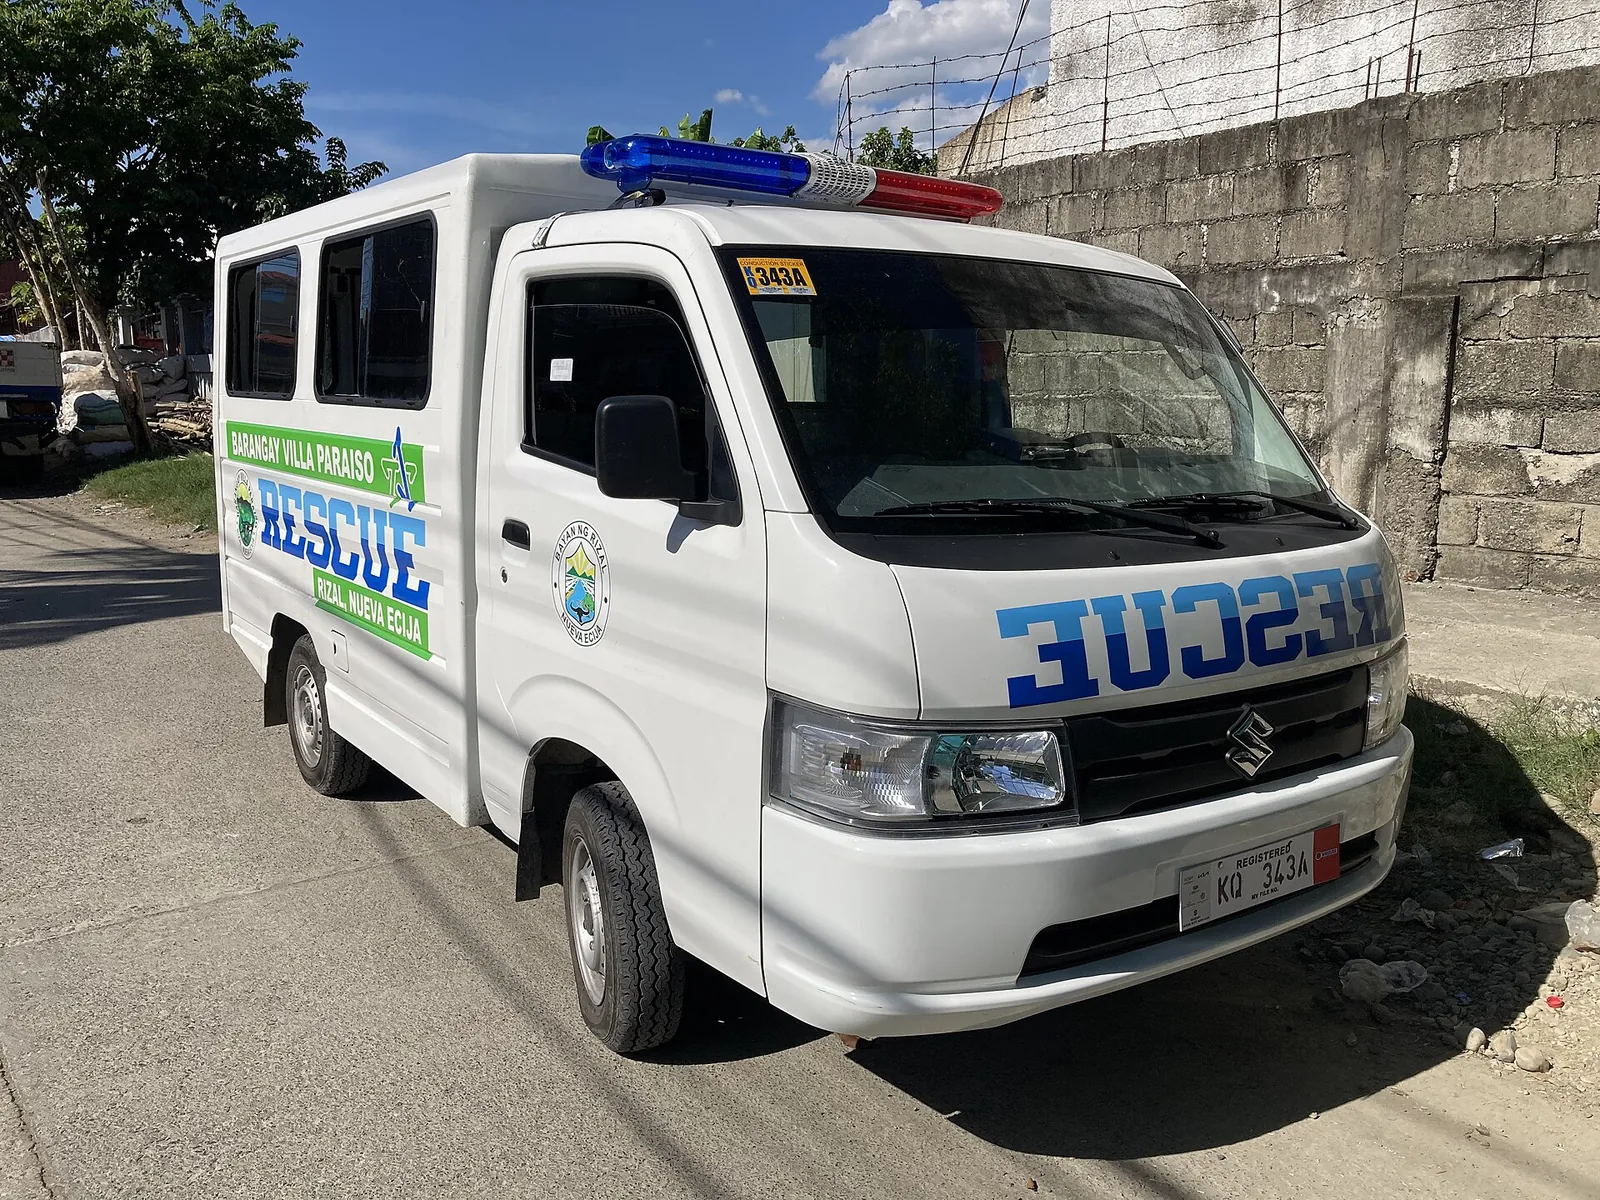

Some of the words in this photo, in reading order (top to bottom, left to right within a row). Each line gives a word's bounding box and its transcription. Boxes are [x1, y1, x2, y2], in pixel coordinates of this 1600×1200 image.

[755, 267, 807, 286] 343A
[231, 430, 280, 463] BARANGAY
[282, 438, 315, 472] VILLA
[316, 444, 375, 484] PARAISO
[257, 478, 430, 610] RESCUE
[555, 525, 576, 562] BAYAN
[577, 524, 589, 537] NG
[589, 532, 608, 574] RIZAL
[317, 576, 347, 612] RIZAL,
[348, 589, 385, 627] NUEVA
[386, 605, 422, 645] ECIJA
[561, 612, 583, 643] NUEVA
[584, 624, 603, 644] ECIJA
[1236, 840, 1293, 870] REGISTERED
[1262, 850, 1308, 889] 343A
